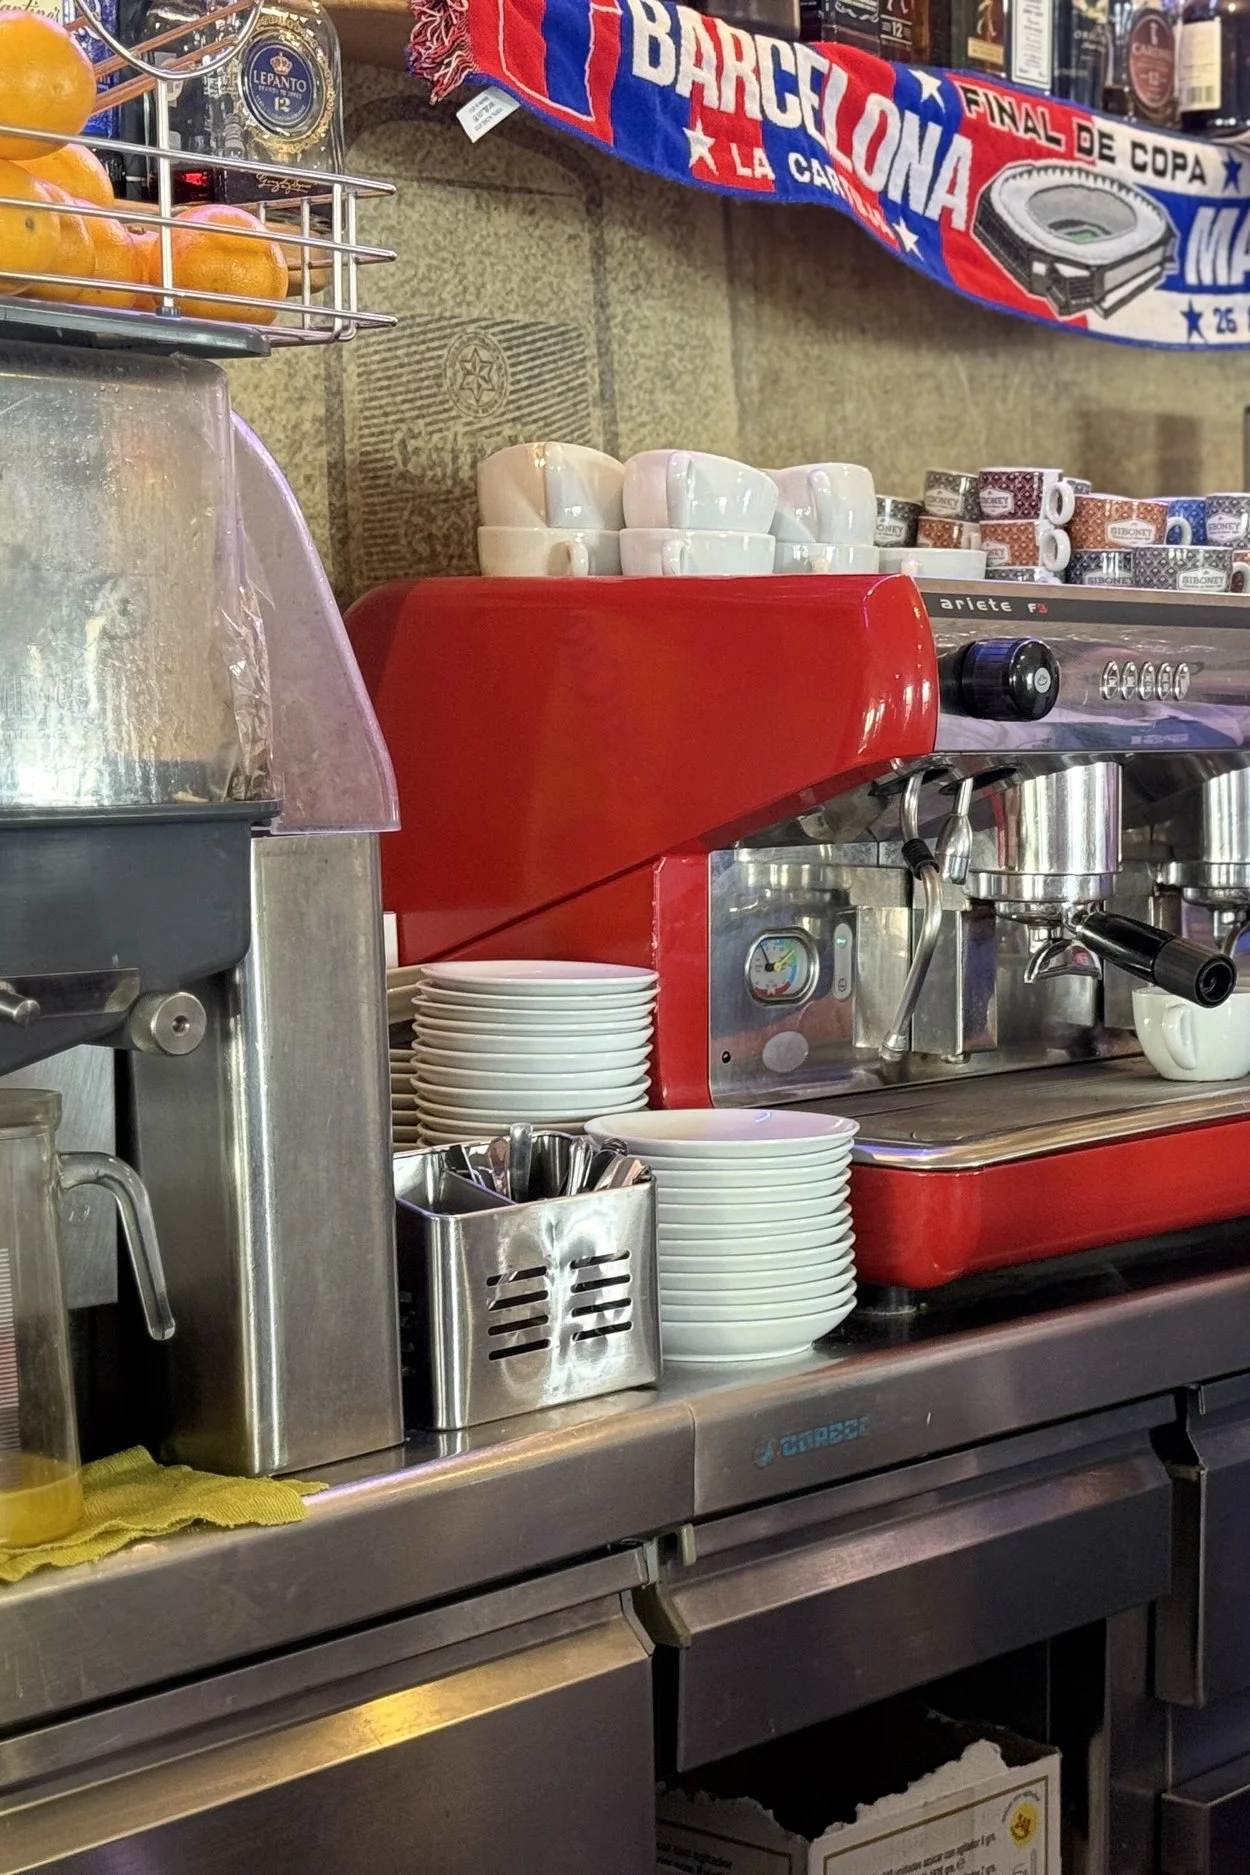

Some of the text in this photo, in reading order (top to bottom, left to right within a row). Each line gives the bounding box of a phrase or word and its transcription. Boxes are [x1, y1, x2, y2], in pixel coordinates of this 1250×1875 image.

[891, 21, 904, 38] 12
[253, 69, 307, 93] LEPANTO
[274, 96, 291, 113] 12
[628, 0, 974, 231] BARCELONA
[959, 84, 1208, 186] FINAL DE COPA
[730, 142, 776, 180] LA
[1213, 307, 1238, 334] 26
[876, 524, 905, 534] ONEY
[1110, 527, 1153, 538] SIBONEY
[1181, 576, 1225, 585] SIBONEY
[940, 597, 1013, 614] ariete
